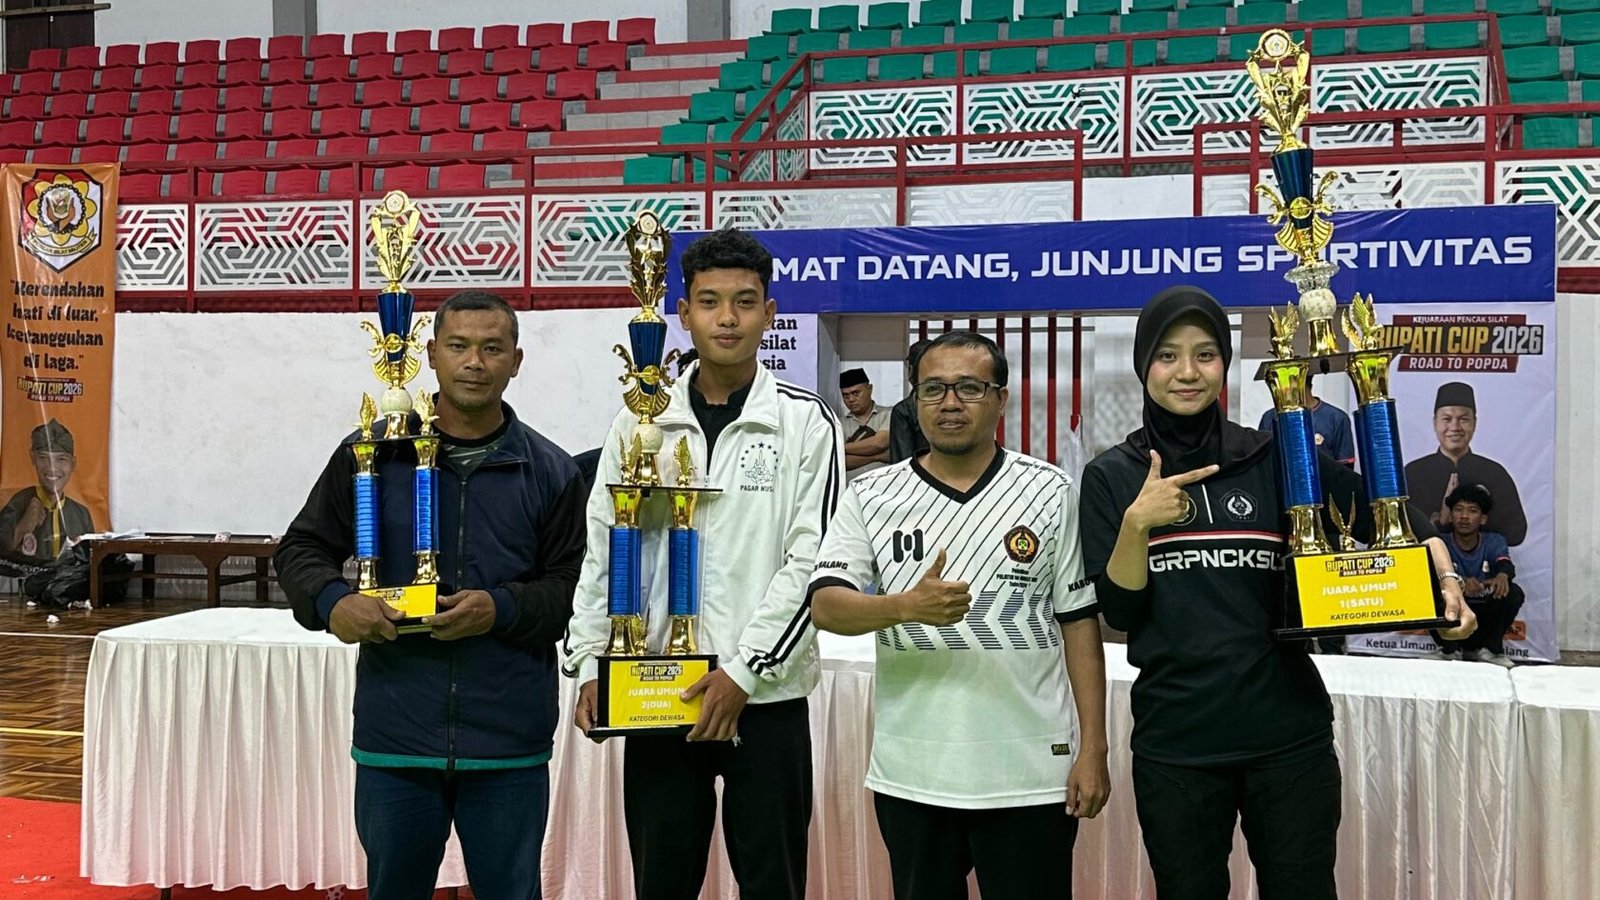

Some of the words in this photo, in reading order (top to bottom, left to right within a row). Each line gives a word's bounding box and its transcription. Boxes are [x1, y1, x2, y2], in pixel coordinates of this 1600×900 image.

[857, 252, 1019, 282] DATANG,
[1031, 246, 1222, 276] JUNJUNG
[1237, 236, 1532, 273] SPRTIVITAS
[13, 302, 43, 320] hati
[47, 304, 62, 321] di
[771, 317, 798, 331] tan
[1412, 316, 1456, 324] KEJUARAAN
[1487, 315, 1509, 323] SILAT
[6, 323, 104, 348] ketangguhan
[1447, 326, 1489, 354] CUP
[1491, 326, 1542, 354] 2026
[23, 353, 40, 368] di
[1409, 357, 1443, 369] ROAD
[1447, 357, 1462, 369] TO
[1466, 357, 1508, 370] POPDA
[47, 382, 64, 395] CUP
[63, 382, 82, 395] 2026
[740, 484, 759, 492] PAGAR
[760, 485, 775, 493] NUS
[1326, 559, 1355, 572] BUPATI
[1356, 558, 1373, 570] CUP
[1374, 556, 1394, 568] 2026
[1322, 584, 1358, 596] JUARA
[1360, 581, 1398, 593] UMUM
[1339, 597, 1385, 609] 1(SATU)
[1330, 612, 1370, 621] KATEGORI
[1371, 609, 1405, 618] DEWASA
[1365, 638, 1397, 649] Ketua
[1400, 640, 1437, 651] Umum
[1505, 645, 1529, 658] lang
[631, 666, 653, 676] BUPATI
[654, 666, 667, 676] CUP
[628, 687, 656, 697] JUARA
